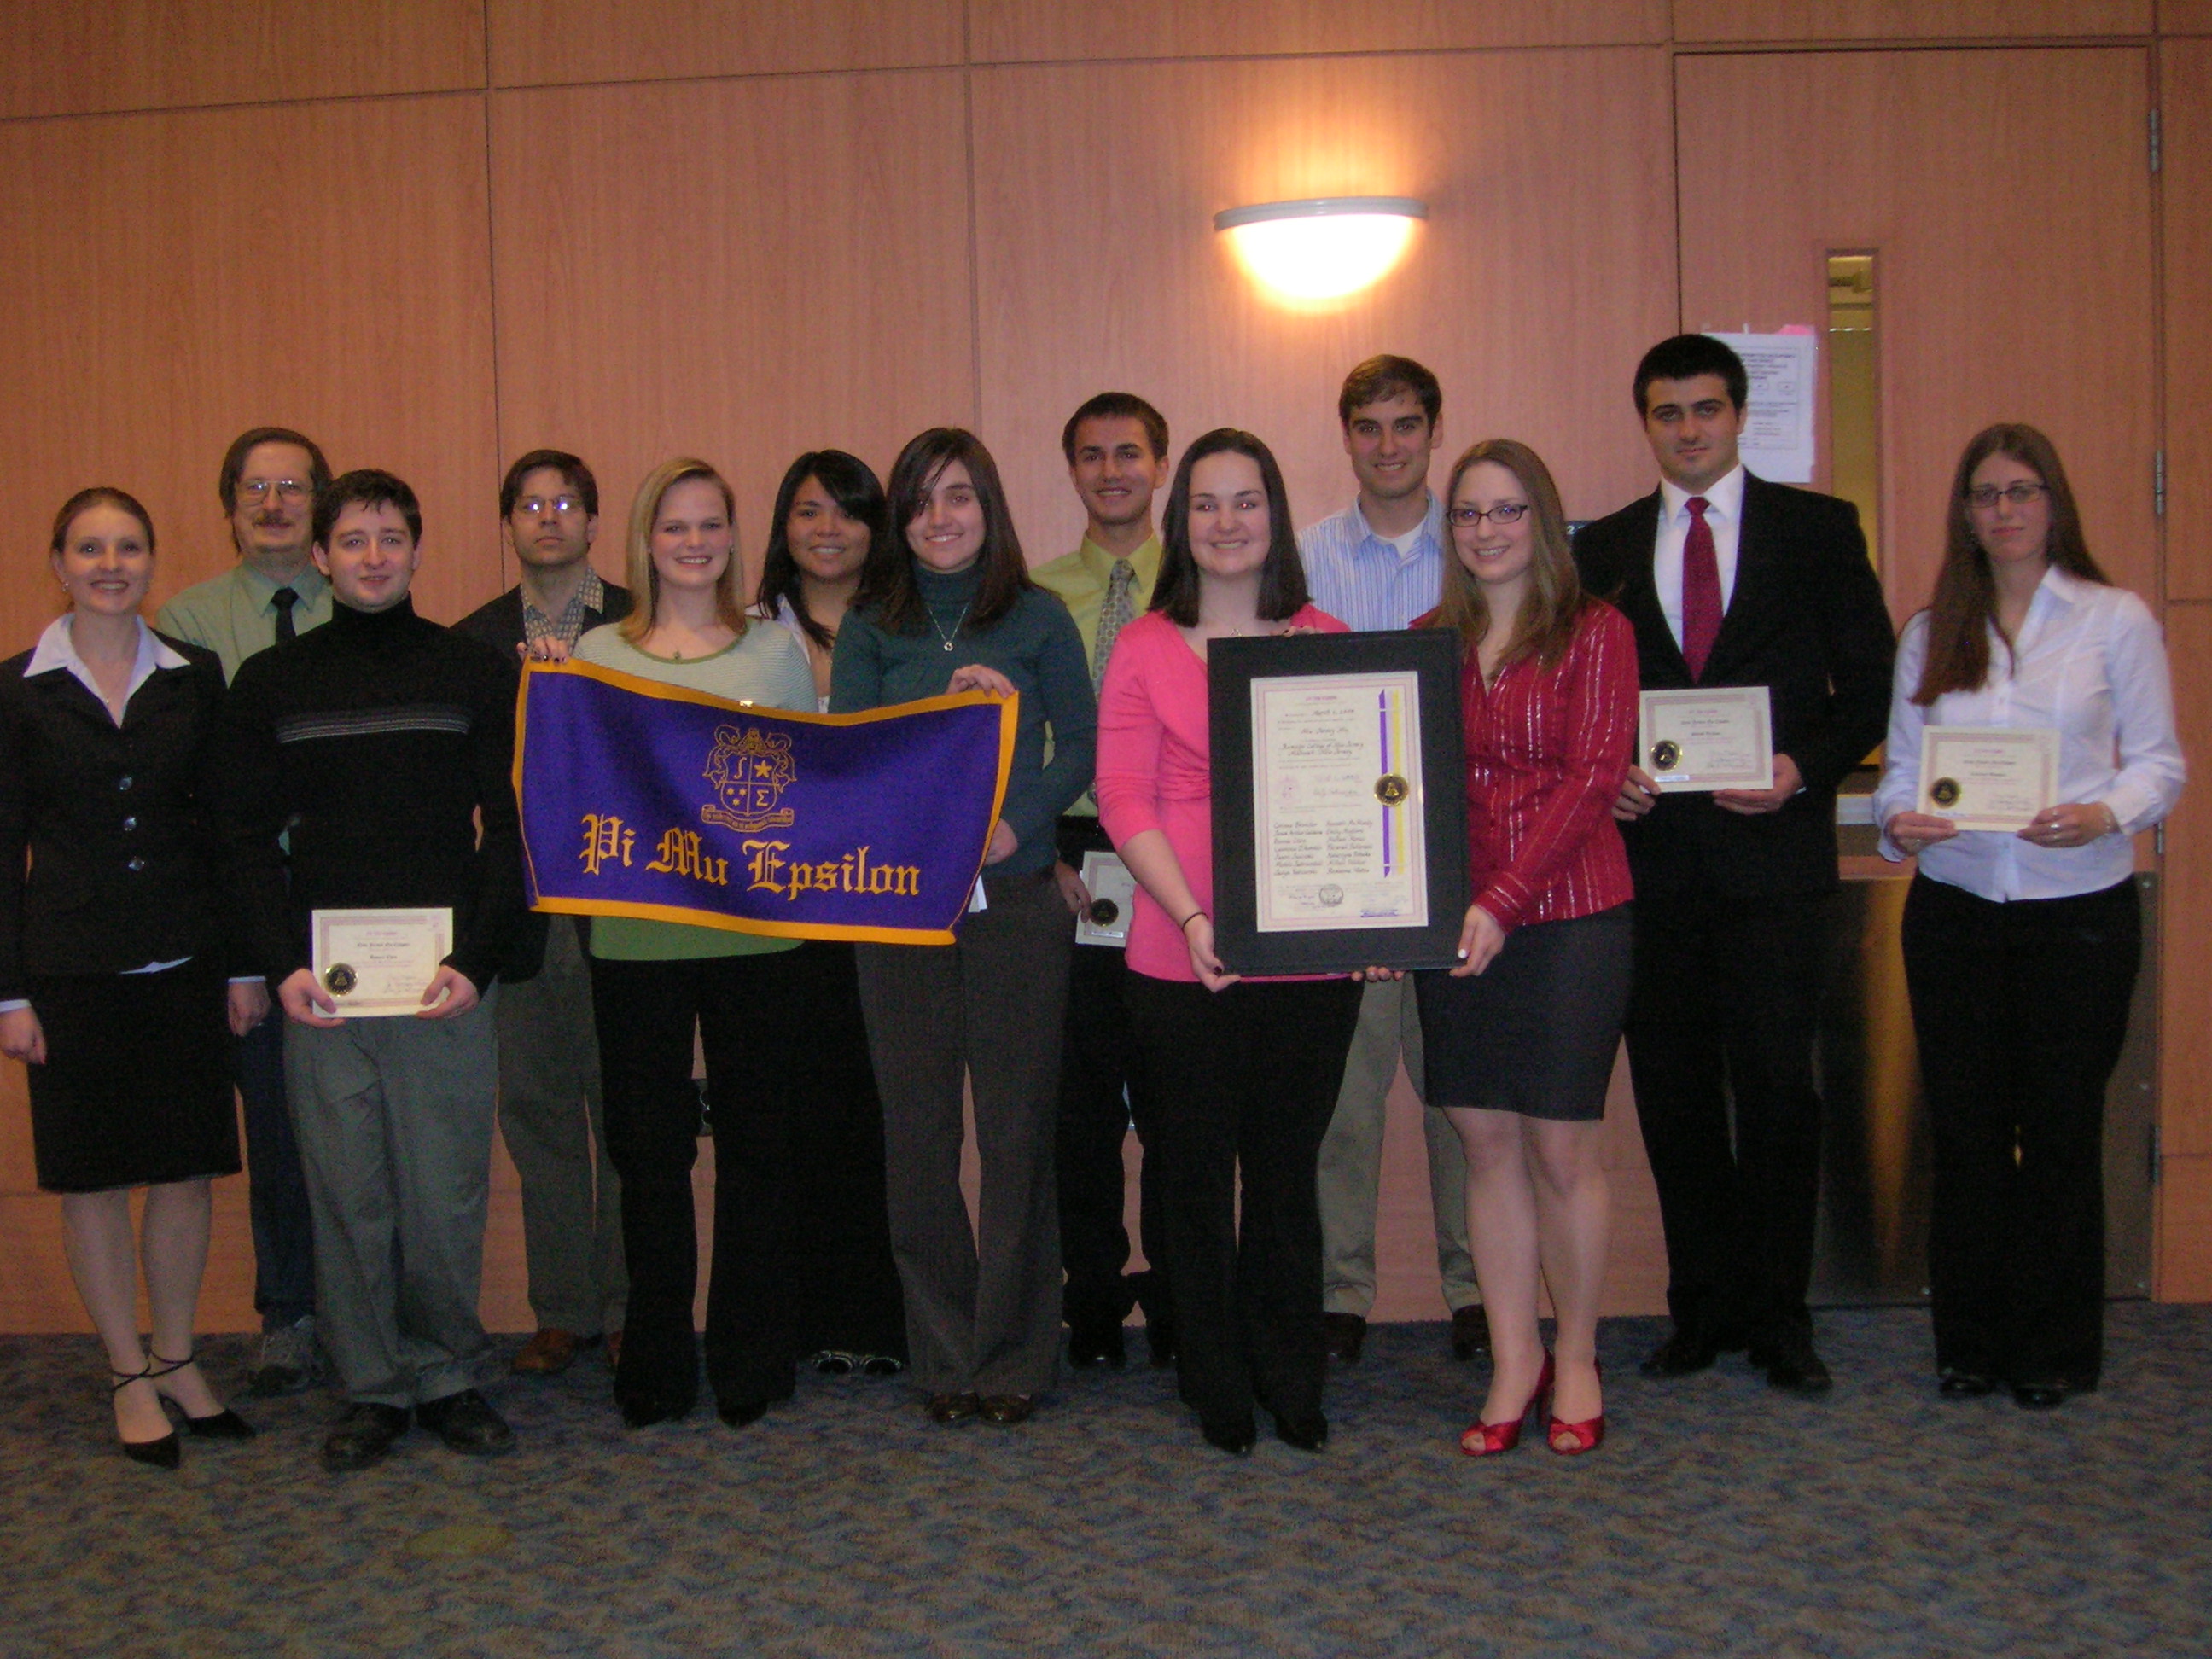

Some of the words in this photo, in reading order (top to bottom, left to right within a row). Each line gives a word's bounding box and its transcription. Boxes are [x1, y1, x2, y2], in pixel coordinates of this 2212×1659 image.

[579, 813, 637, 876] Pi
[645, 827, 729, 886] Mu
[742, 840, 921, 902] Epsilon
